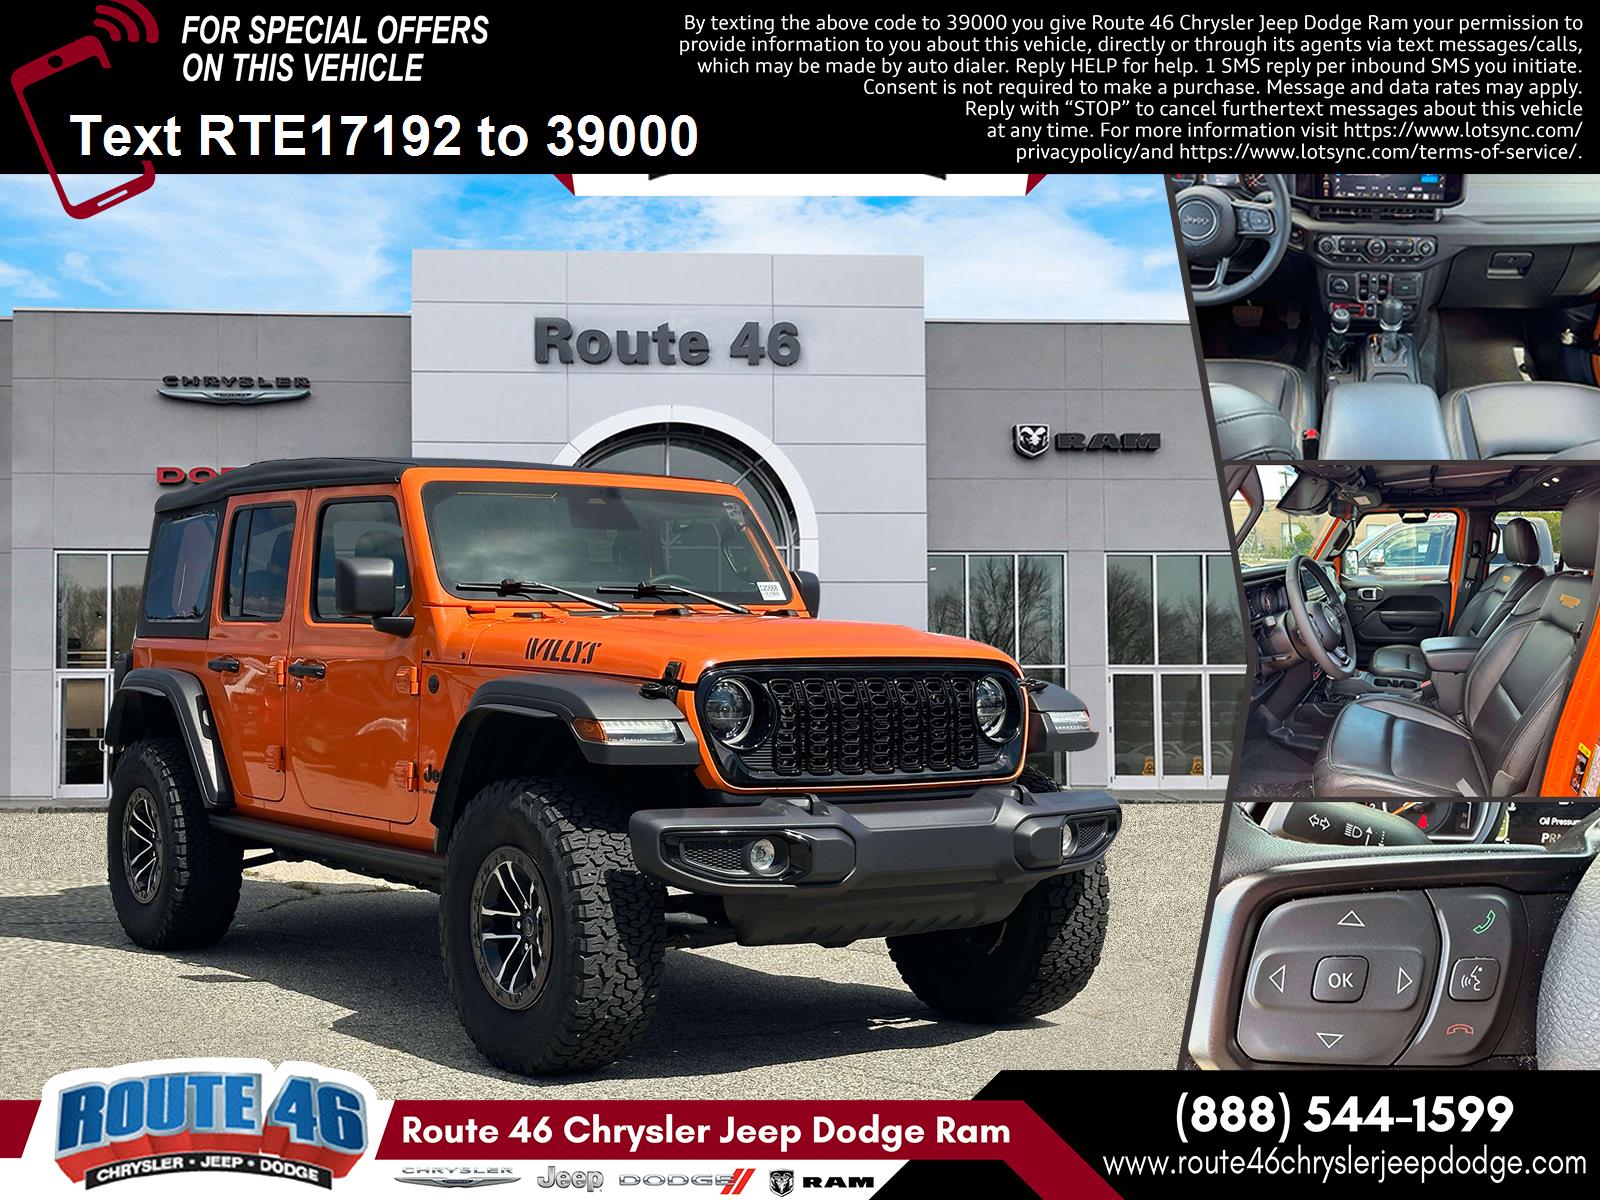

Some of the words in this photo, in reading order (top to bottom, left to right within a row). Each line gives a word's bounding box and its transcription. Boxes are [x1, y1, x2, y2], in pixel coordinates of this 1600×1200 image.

[535, 318, 710, 366] Route
[730, 322, 800, 367] 46
[162, 375, 311, 389] CHRYSLER
[1055, 433, 1161, 452] RAM
[525, 638, 602, 664] WILLYS
[1539, 816, 1550, 826] Oil
[1328, 973, 1353, 989] OK
